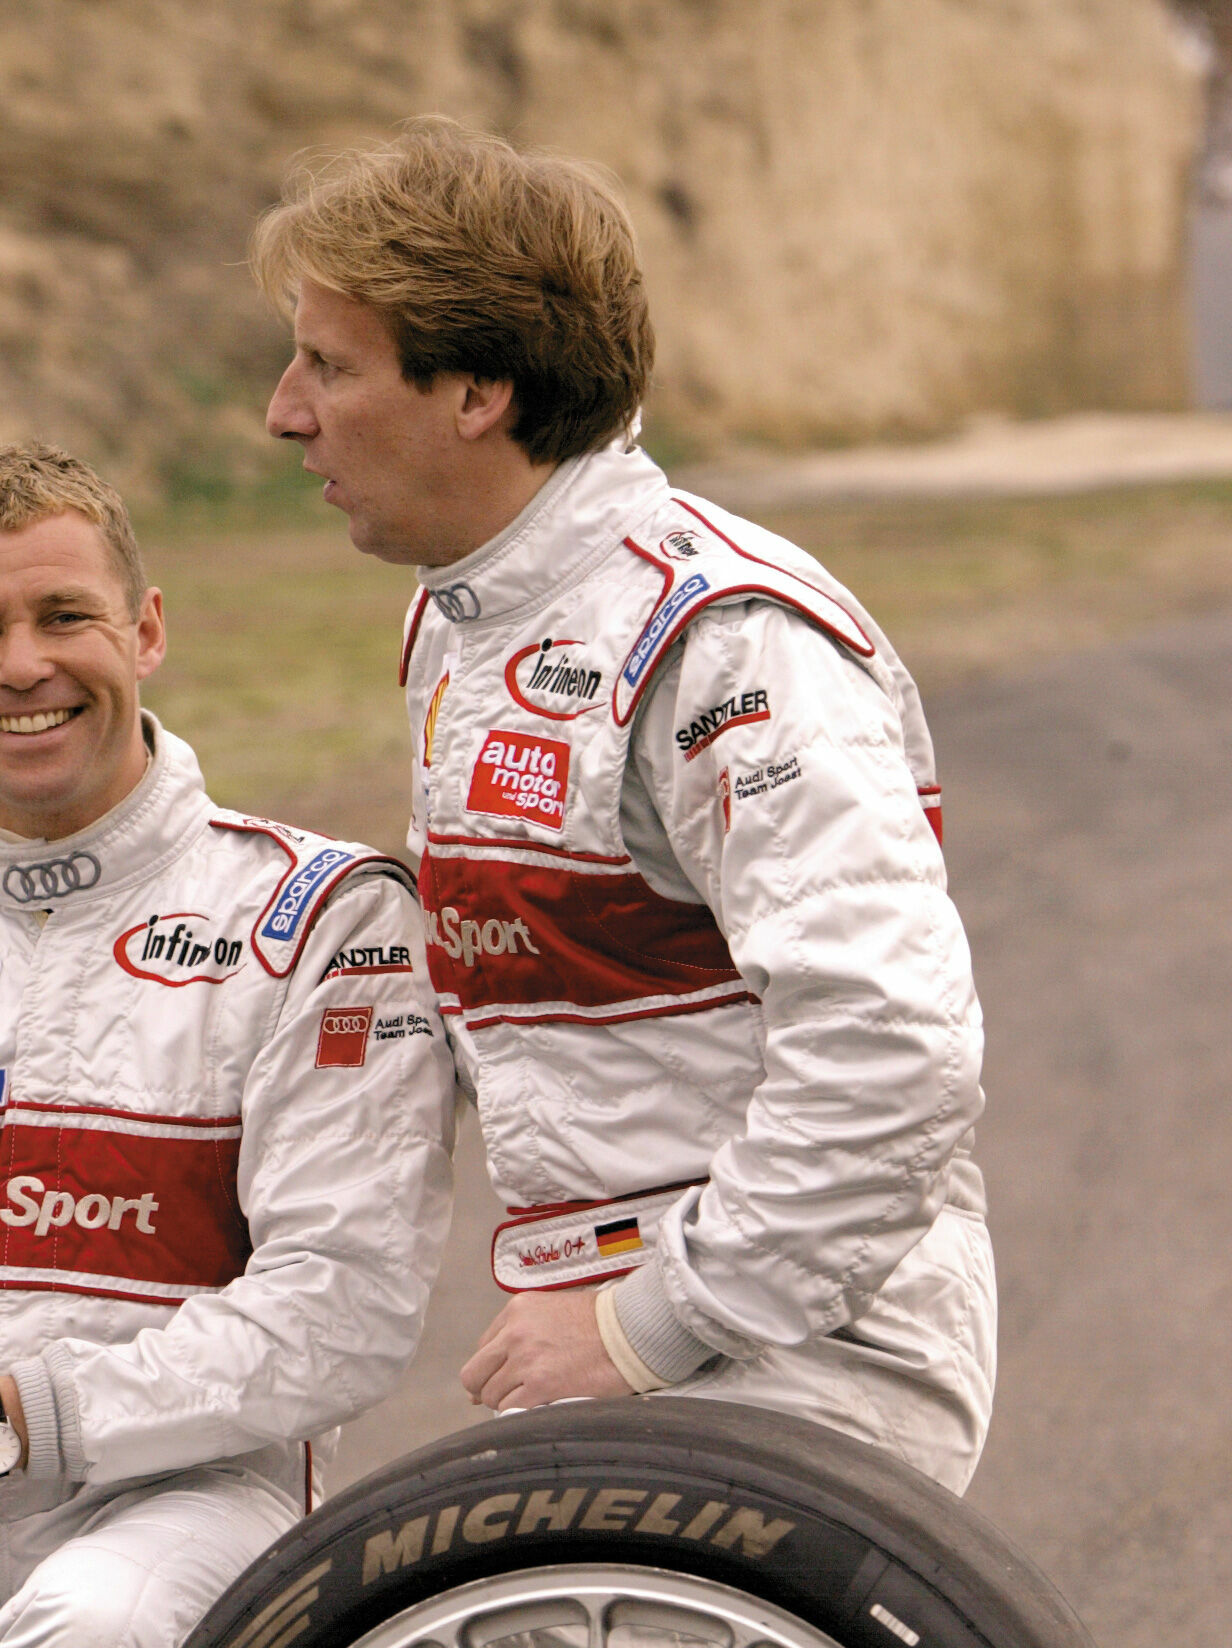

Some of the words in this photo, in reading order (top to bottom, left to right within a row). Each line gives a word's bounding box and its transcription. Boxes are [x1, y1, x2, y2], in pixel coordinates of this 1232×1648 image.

[734, 769, 764, 789] Audi
[767, 757, 798, 778] Sport
[734, 785, 768, 800] Team
[271, 851, 348, 934] sparco
[324, 946, 412, 972] ANDTLER
[433, 906, 541, 968] Sport
[362, 1487, 796, 1586] MICHELIN
